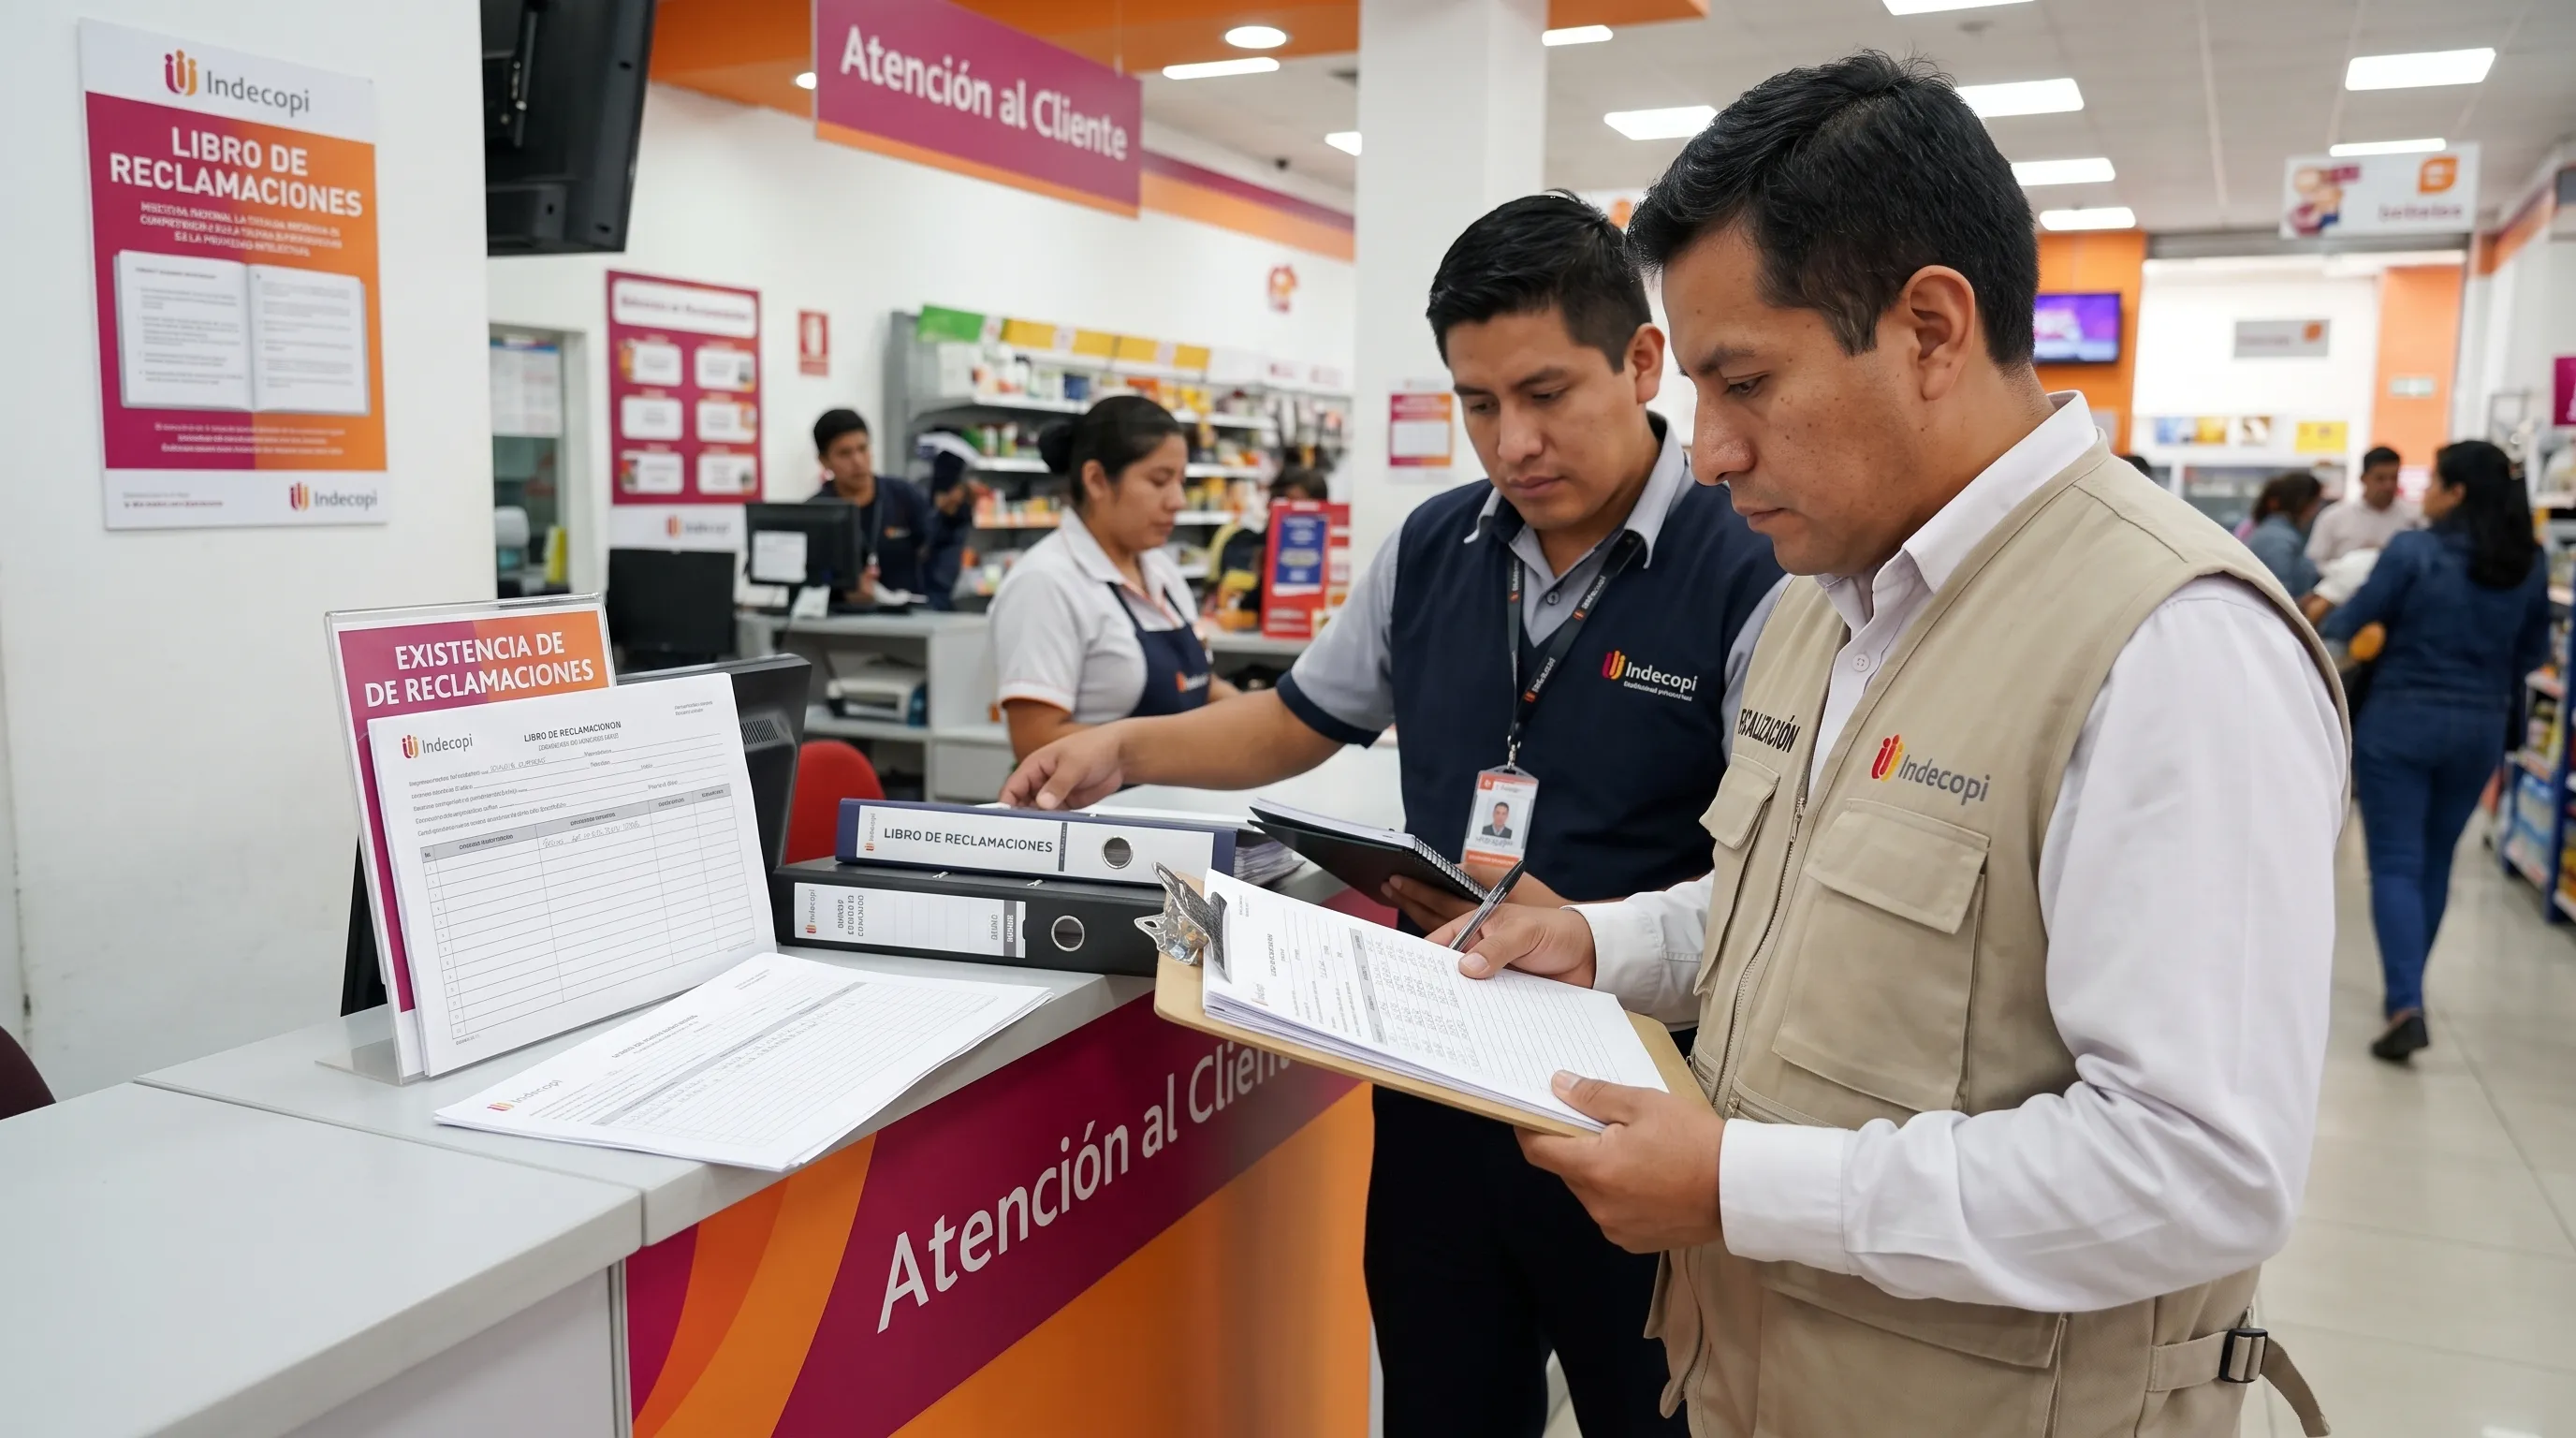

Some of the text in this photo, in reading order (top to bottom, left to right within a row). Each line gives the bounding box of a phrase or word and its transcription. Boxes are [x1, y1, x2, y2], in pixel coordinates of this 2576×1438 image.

[207, 70, 310, 118] Indecopi
[841, 24, 1128, 161] Atención al Cliente
[171, 126, 309, 177] LIBRO DE
[110, 152, 363, 218] RECLAMACIONES
[314, 489, 378, 512] Indecopi
[394, 631, 565, 670] EXISTENCIA DE
[365, 658, 594, 708] DE RECLAMACIONES
[1625, 661, 1699, 694] Indecopi
[422, 733, 474, 755] Indecopi
[524, 731, 547, 742] LIBRO
[549, 728, 559, 739] DE
[1897, 754, 1991, 806] Indecopi
[884, 827, 1053, 853] LIBRO DE RECLAMACIONES
[877, 1041, 1291, 1334] Atención al Clien
